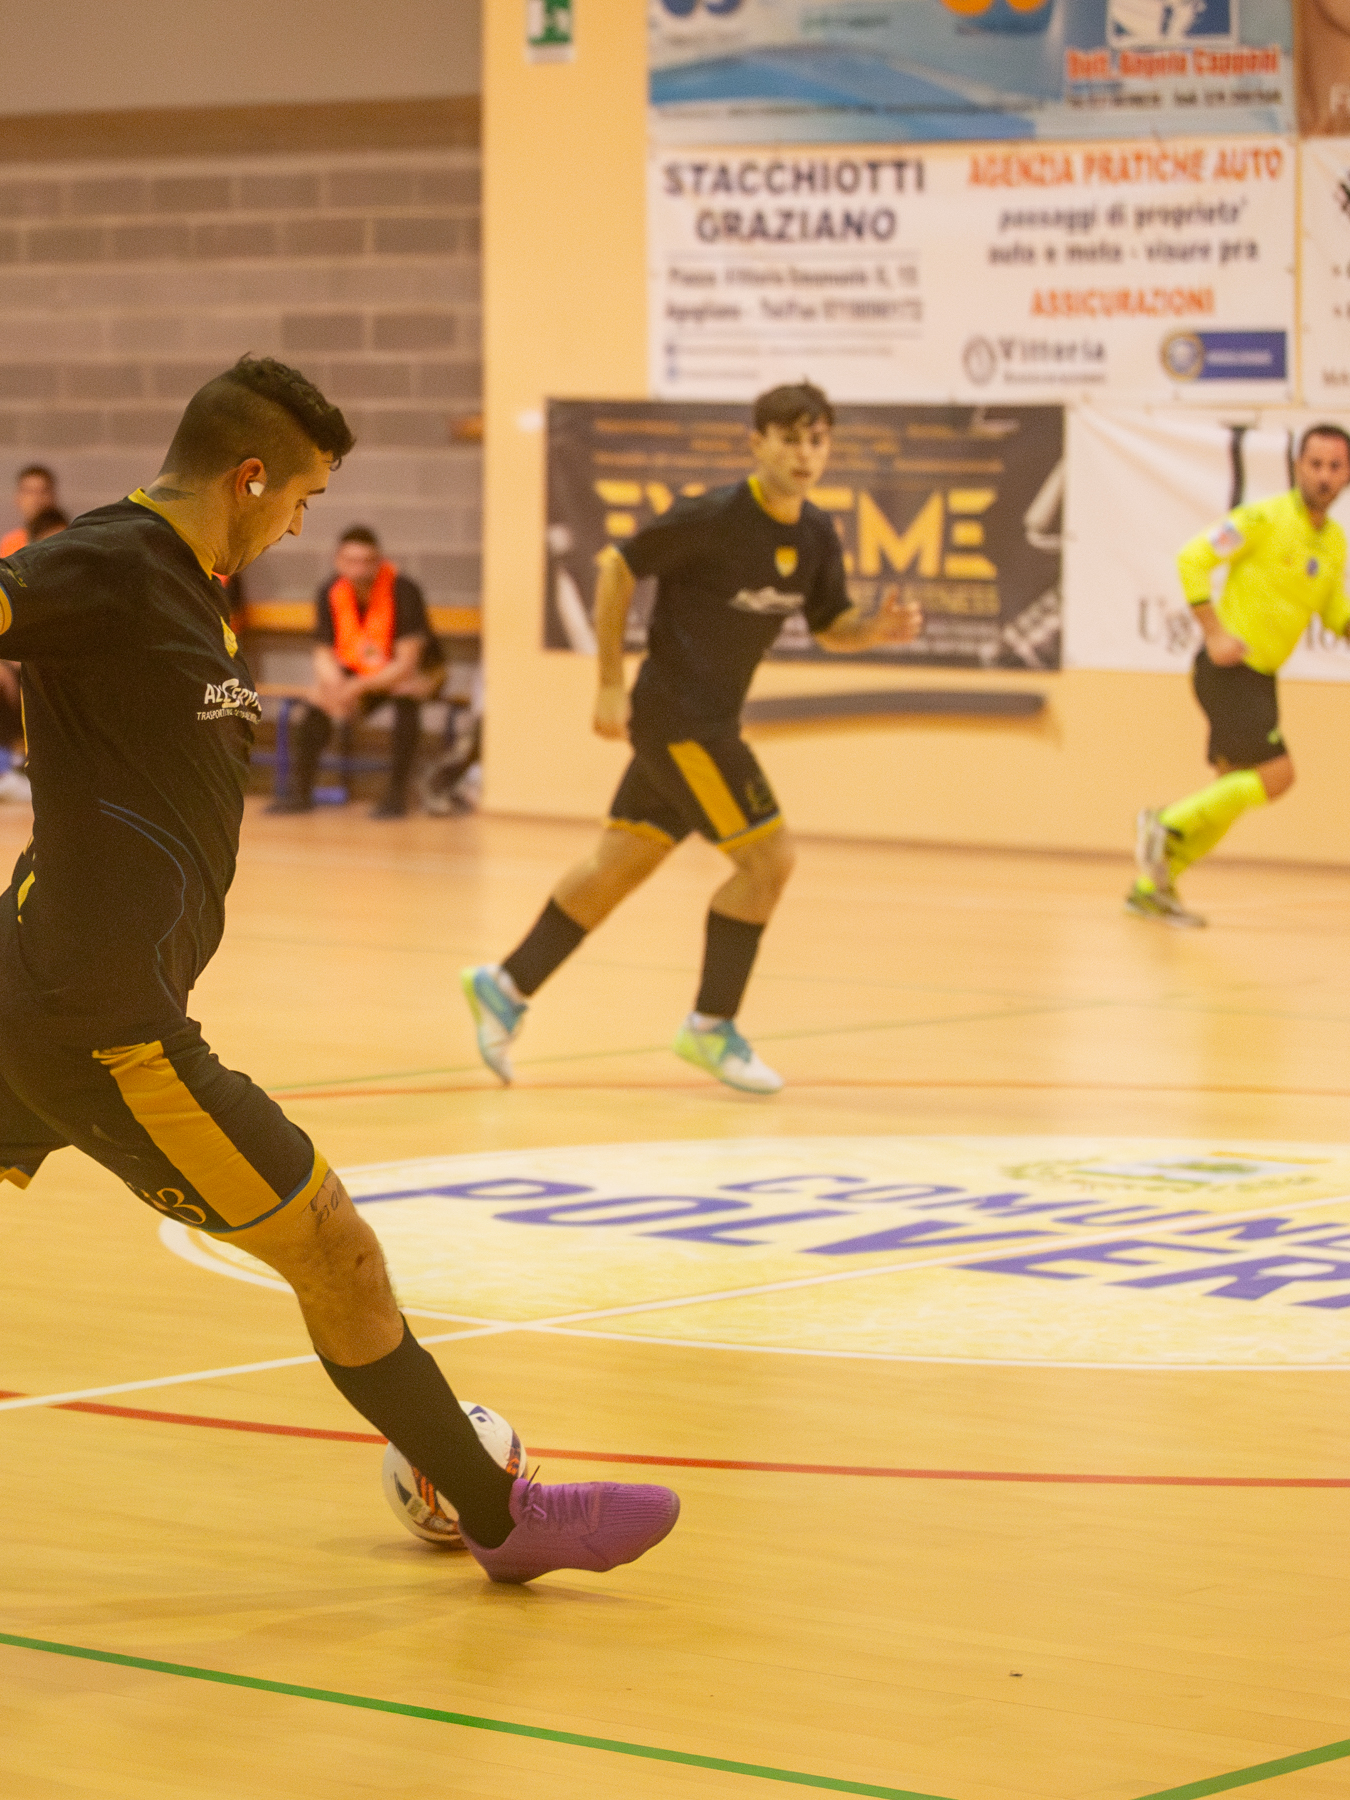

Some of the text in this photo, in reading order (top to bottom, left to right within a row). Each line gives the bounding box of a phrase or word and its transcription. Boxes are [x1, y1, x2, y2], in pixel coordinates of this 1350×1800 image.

[664, 159, 925, 195] STACCHIOTTI
[968, 146, 1283, 188] AGENZIA PRATICHE AUTO
[695, 206, 896, 242] GRAZIANO
[1030, 287, 1216, 319] ASSICURAZIONI
[352, 1177, 1350, 1310] POLVER
